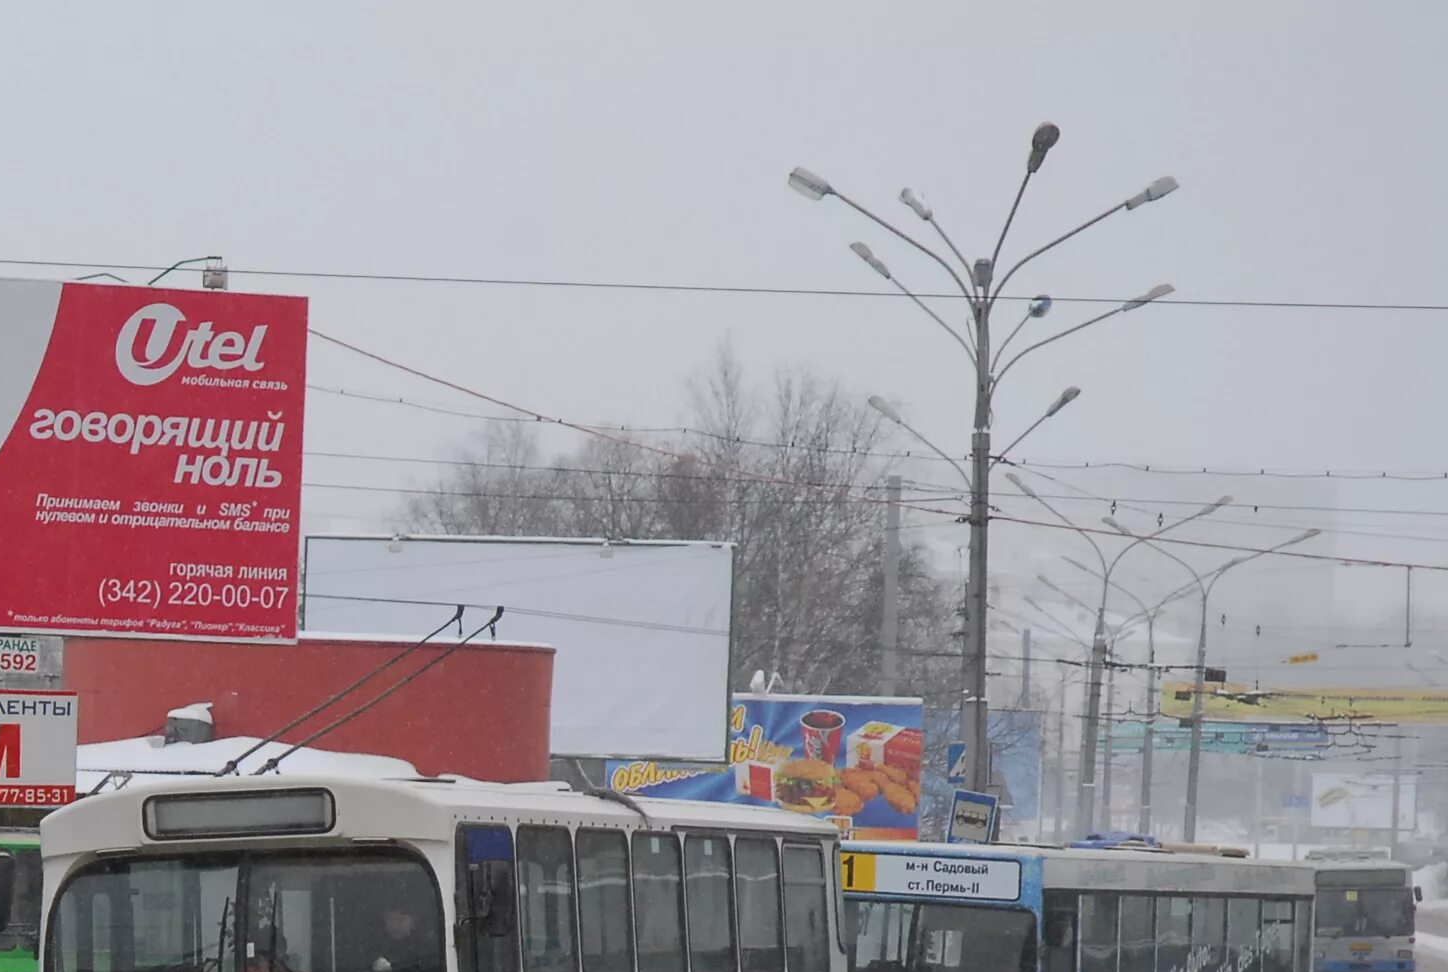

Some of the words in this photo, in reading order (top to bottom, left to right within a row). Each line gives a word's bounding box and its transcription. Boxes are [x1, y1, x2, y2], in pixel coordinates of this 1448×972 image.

[115, 303, 268, 386] Utel
[181, 374, 250, 389] мобильная
[252, 380, 288, 391] связь
[30, 408, 285, 457] говорящий
[173, 454, 283, 488] ноль
[36, 493, 121, 511] Принимаем
[133, 501, 184, 514] звонки
[197, 504, 206, 515] и
[263, 508, 291, 521] при
[35, 510, 95, 525] нулевом
[98, 514, 107, 524] и
[111, 515, 230, 531] отрицательном
[234, 517, 290, 533] балансе
[169, 562, 233, 579] горячая
[238, 566, 288, 581] линия
[98, 578, 161, 609] (342)
[168, 582, 289, 609] 220-00-07
[50, 614, 98, 625] абоненты
[100, 618, 144, 627] тарифов
[906, 861, 928, 871] м-н
[934, 860, 989, 875] Садовый
